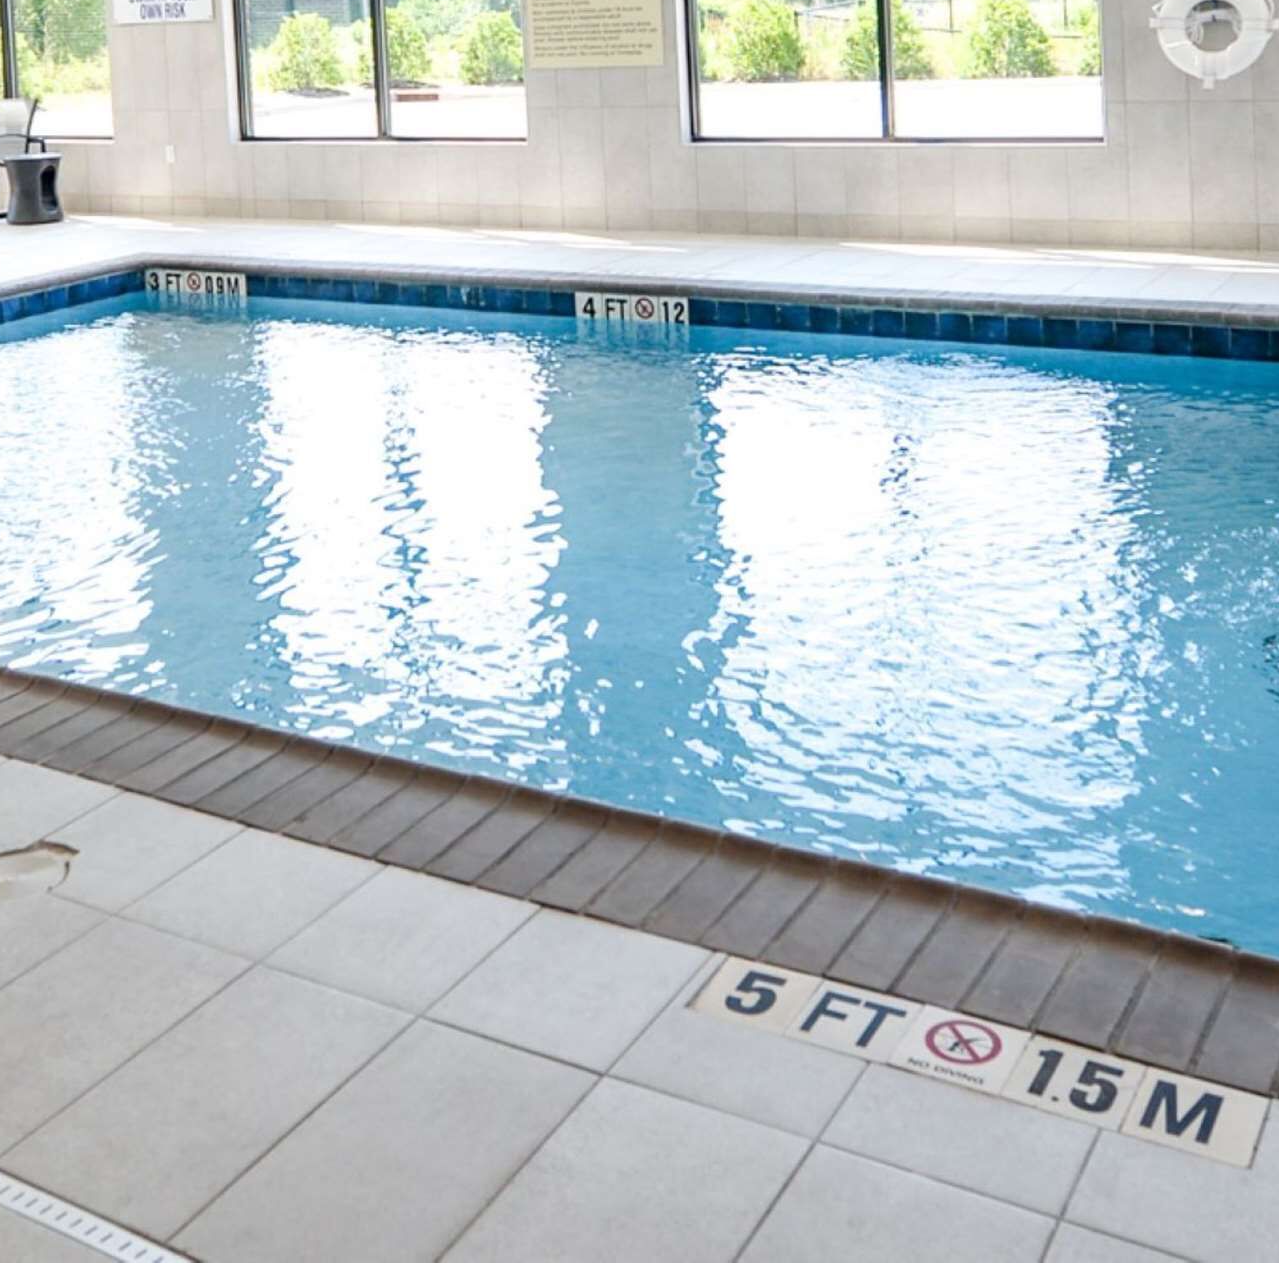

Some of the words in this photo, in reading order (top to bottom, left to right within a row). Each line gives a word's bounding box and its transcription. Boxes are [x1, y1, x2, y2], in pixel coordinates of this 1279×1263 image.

[140, 3, 162, 20] OWN
[164, 2, 186, 18] RISK
[148, 271, 160, 291] 3
[165, 273, 181, 293] FT
[582, 296, 596, 319] 4
[604, 298, 628, 321] FT
[724, 970, 787, 1016] 5
[799, 990, 907, 1048] FT
[1139, 1079, 1225, 1145] M
